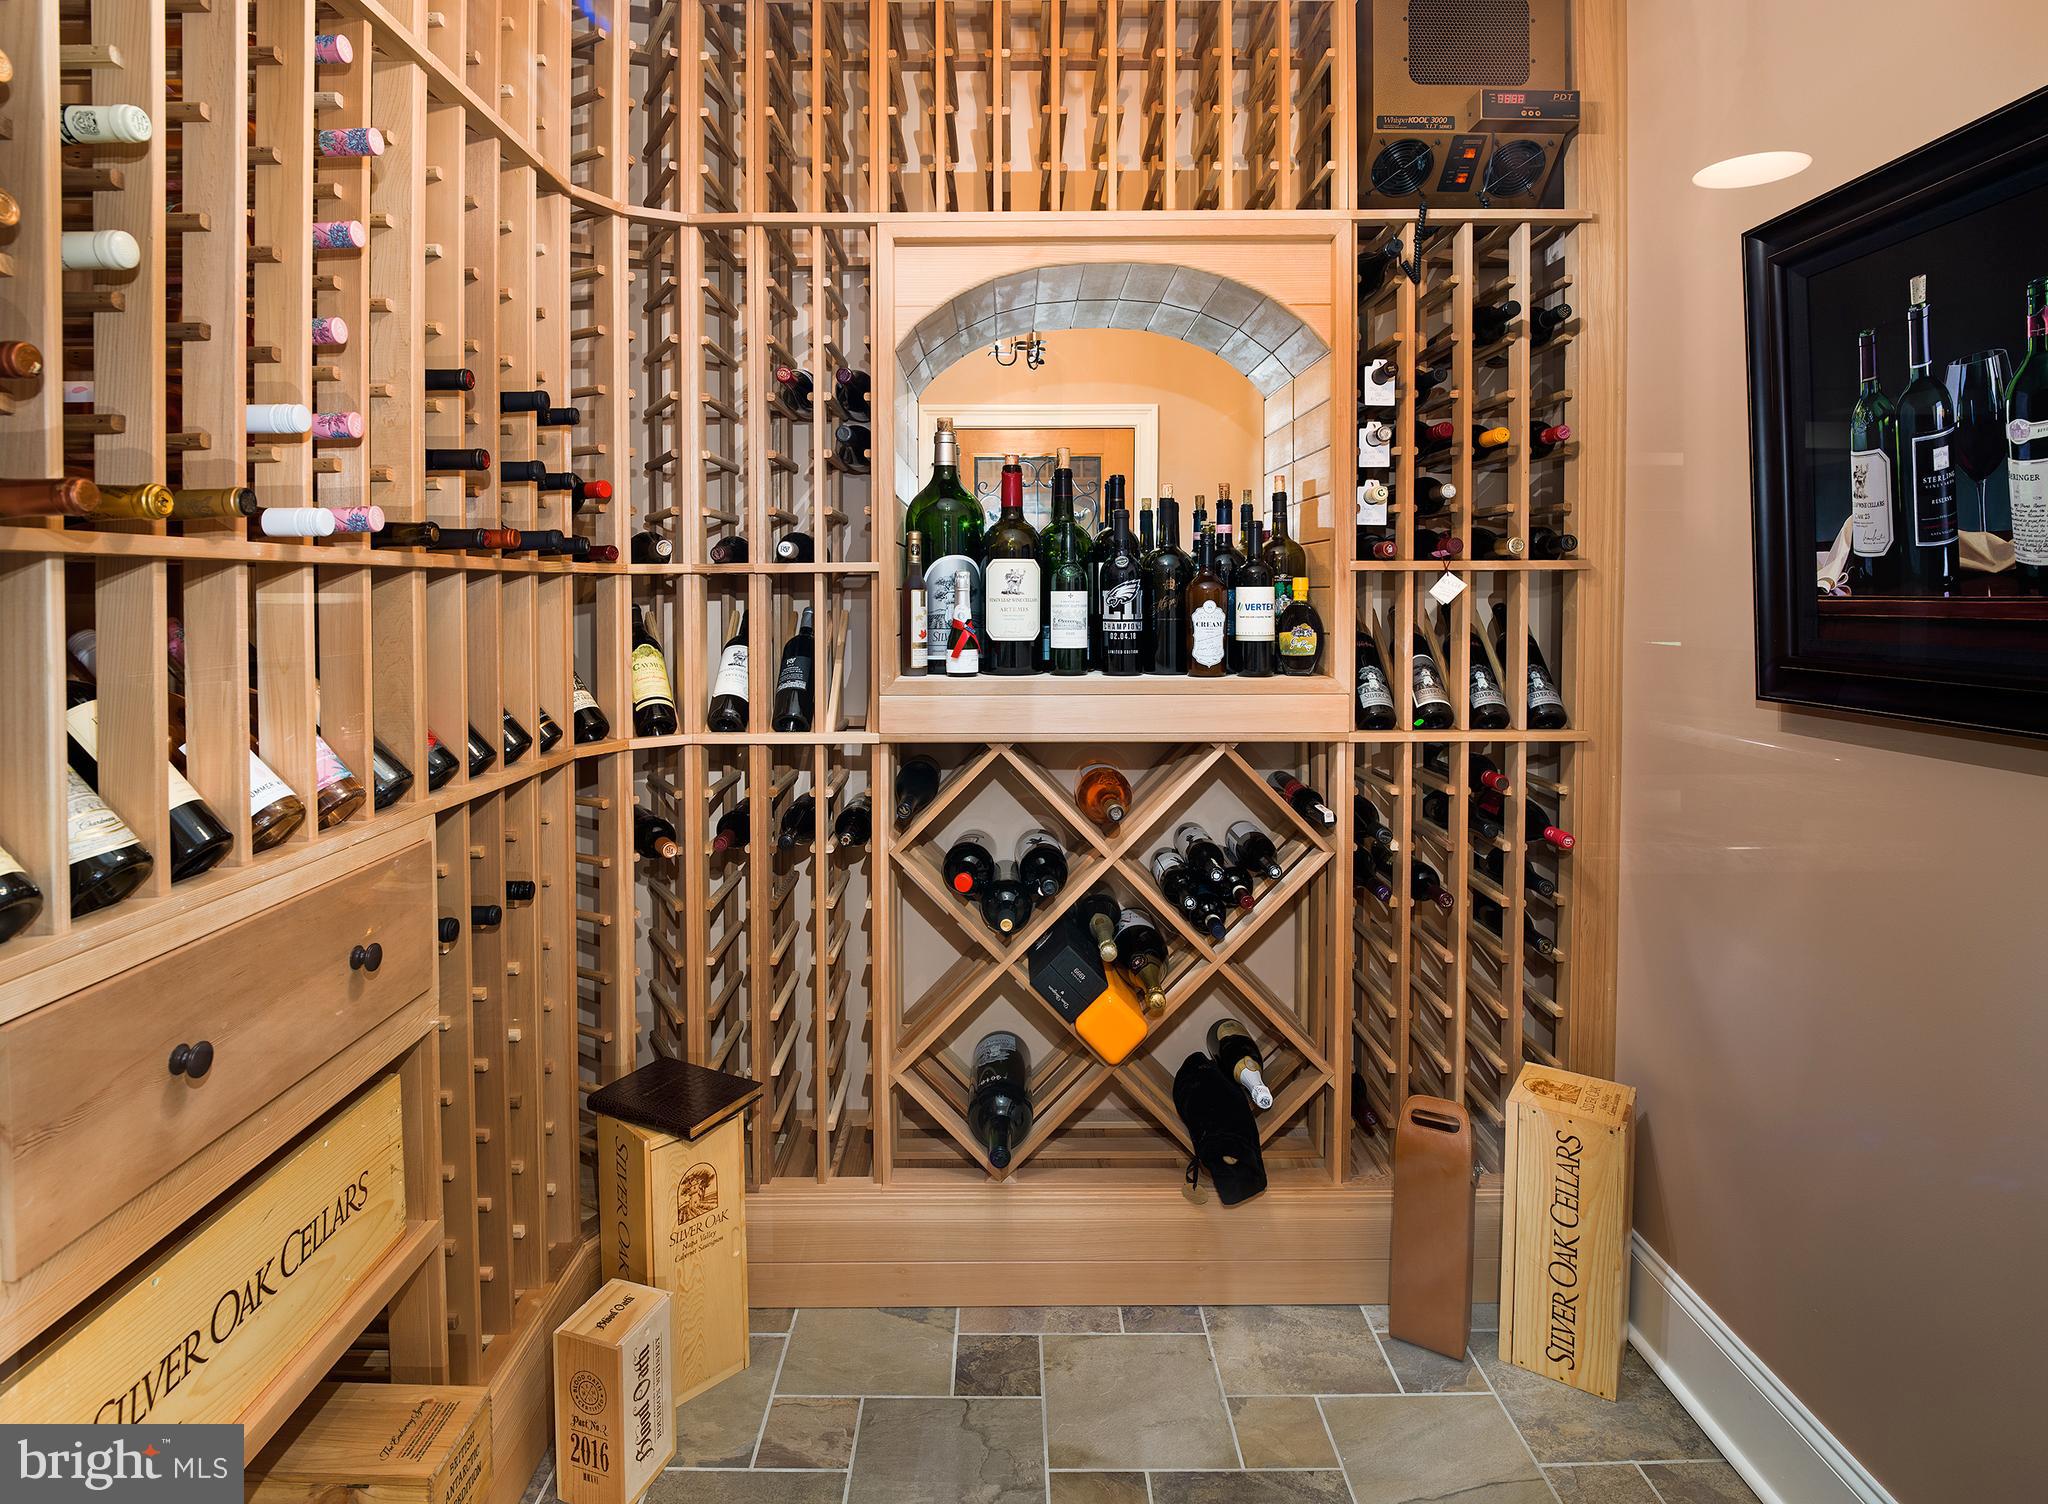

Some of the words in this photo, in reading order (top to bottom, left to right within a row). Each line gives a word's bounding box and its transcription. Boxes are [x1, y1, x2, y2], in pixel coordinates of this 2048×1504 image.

[1553, 93, 1573, 101] PDT
[1384, 116, 1430, 125] WhisperKOOL
[1430, 116, 1448, 124] 3000
[1922, 470, 1955, 484] STERLING
[1932, 496, 1952, 504] RESERVE
[1110, 632, 1136, 640] 02.04.18
[250, 782, 273, 798] UMMER
[615, 1135, 629, 1218] SILVER
[1550, 1129, 1584, 1229] CELLARS
[669, 1222, 704, 1247] SILVER
[705, 1209, 728, 1228] OAK
[210, 1257, 278, 1344] OAK
[281, 1170, 369, 1278] CELLARS
[617, 1221, 630, 1280] OAK
[1548, 1234, 1580, 1289] OAK
[1545, 1292, 1580, 1370] SILVER
[573, 1374, 586, 1393] BLOOD
[587, 1375, 603, 1391] OATH
[633, 1344, 650, 1401] Oath
[570, 1415, 588, 1428] Part
[578, 1399, 604, 1412] CERTIFIED
[634, 1399, 654, 1462] Blood
[380, 1445, 393, 1461] The
[450, 1430, 475, 1476] BRITISH
[570, 1433, 609, 1472] 2016
